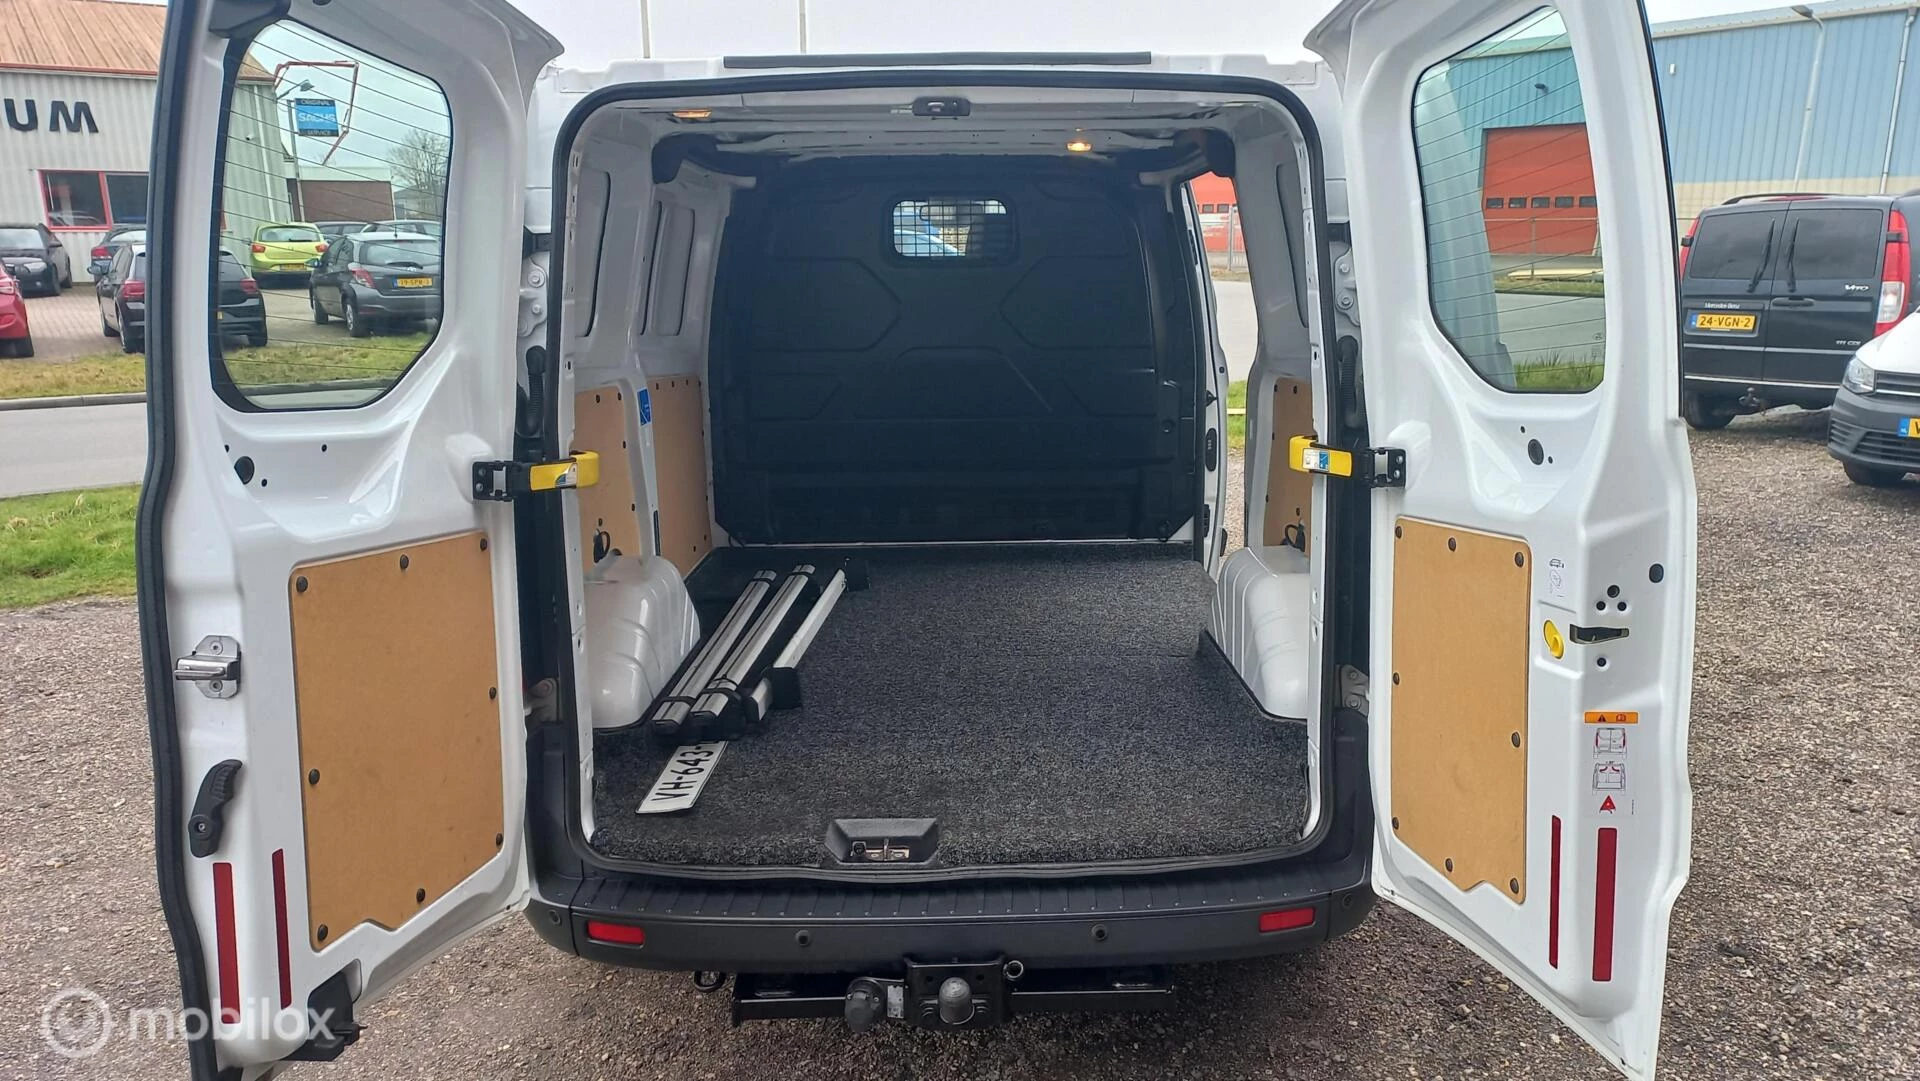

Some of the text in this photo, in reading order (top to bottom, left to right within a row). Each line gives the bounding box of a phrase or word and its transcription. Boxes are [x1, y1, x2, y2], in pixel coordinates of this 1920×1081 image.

[298, 112, 336, 122] SACHS
[1700, 315, 1752, 328] 24-VGN-2
[651, 741, 719, 802] VH-643-
